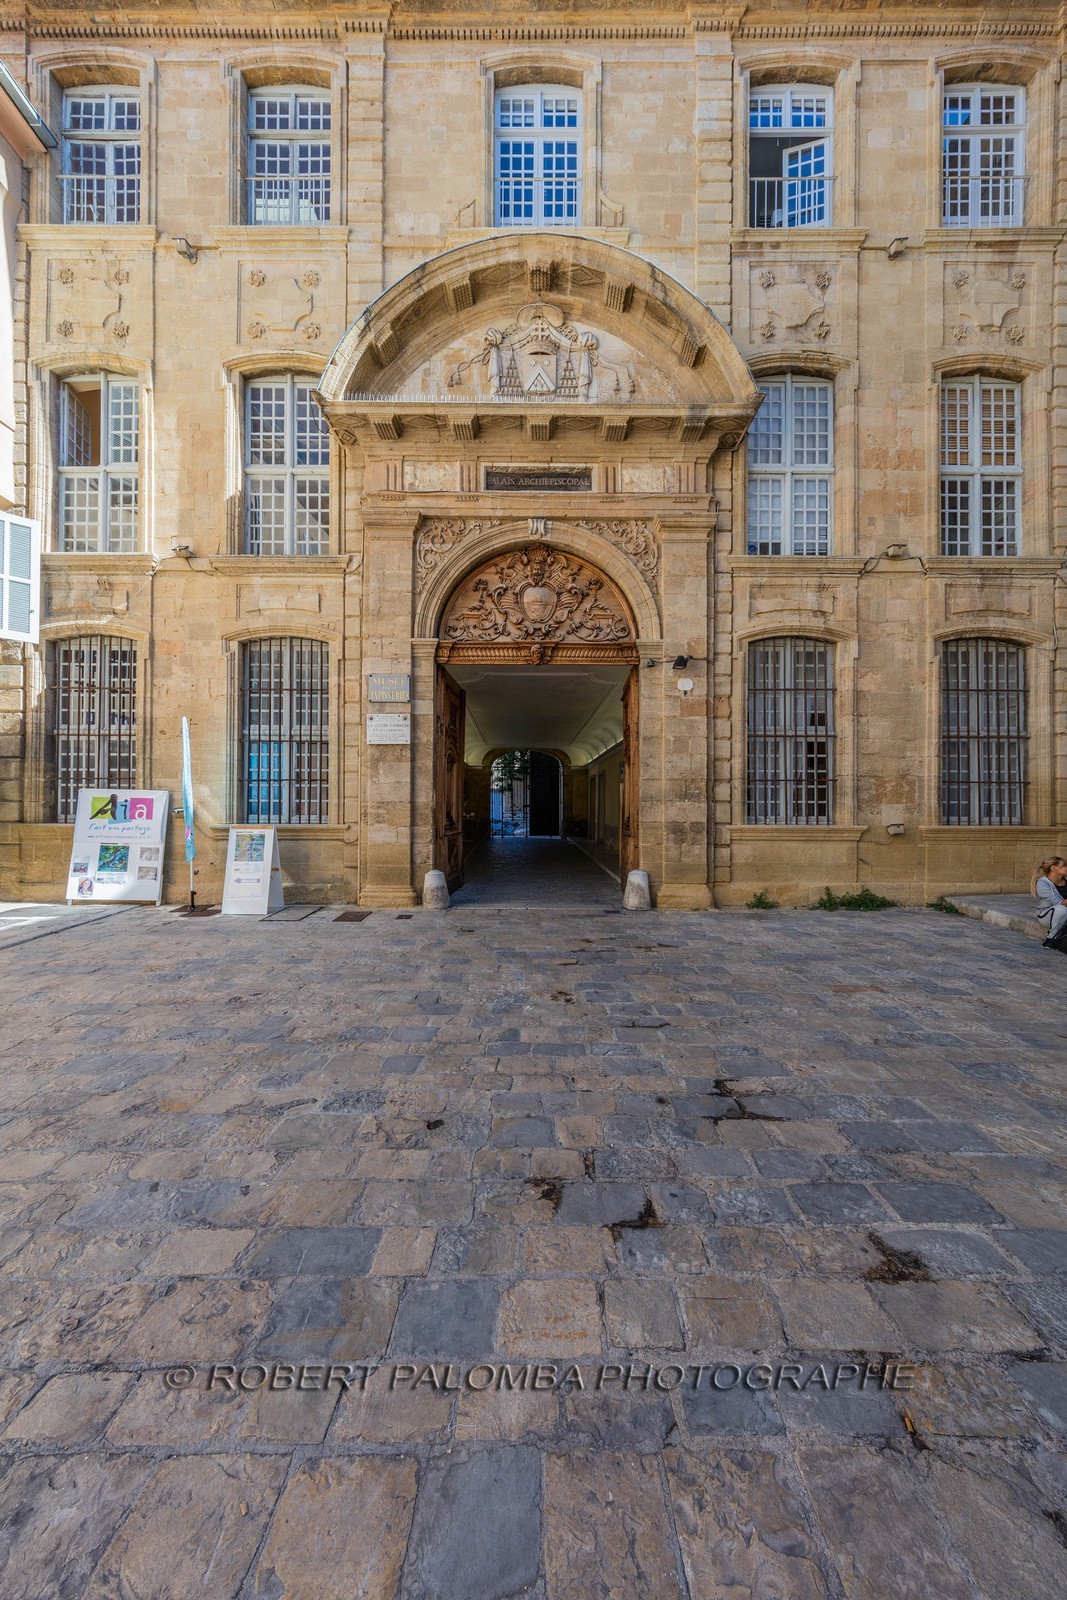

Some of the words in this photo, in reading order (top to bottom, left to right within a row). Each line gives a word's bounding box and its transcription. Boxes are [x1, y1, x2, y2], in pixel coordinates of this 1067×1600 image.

[487, 477, 516, 485] PALAIS
[517, 477, 591, 486] ARCHIEPISCOPAL
[88, 823, 107, 831] l'art
[121, 824, 151, 835] partage
